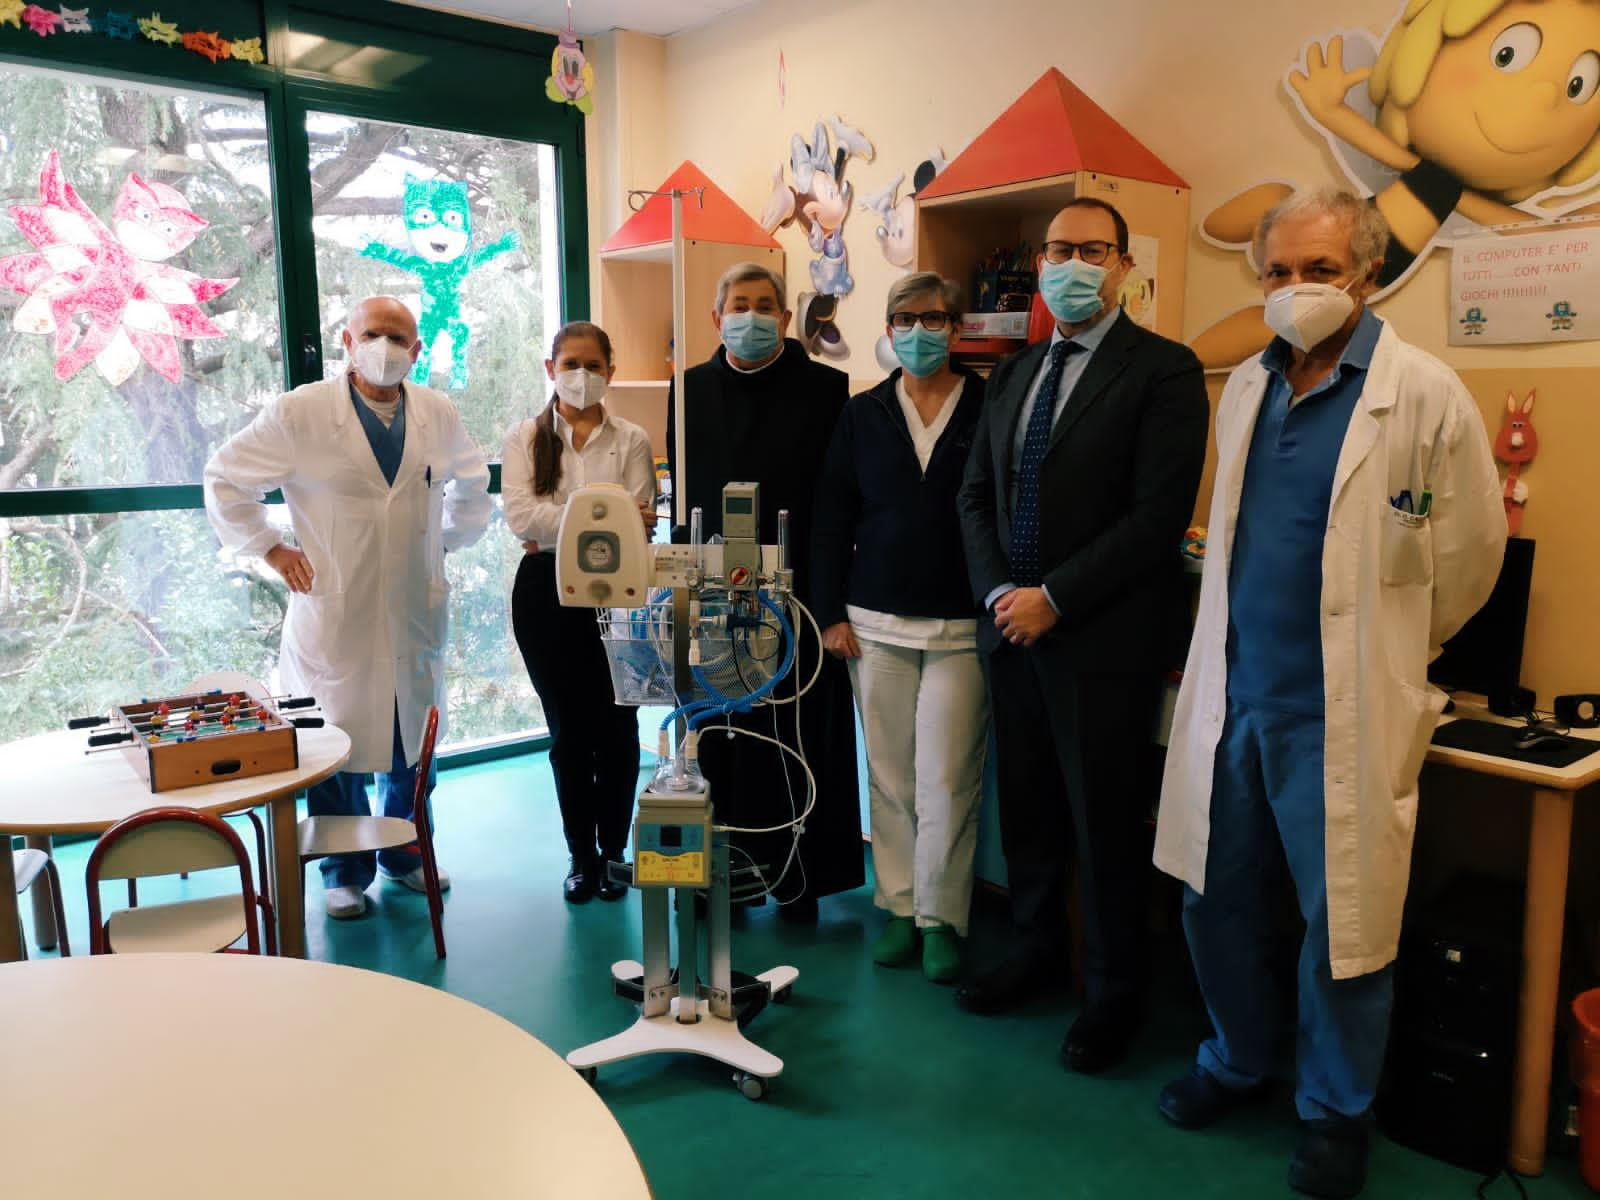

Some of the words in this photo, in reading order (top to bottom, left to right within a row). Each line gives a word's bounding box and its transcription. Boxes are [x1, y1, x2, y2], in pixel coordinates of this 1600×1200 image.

[1463, 255, 1471, 263] IL
[1477, 247, 1542, 263] COMPUTER
[1566, 242, 1589, 254] PER
[1546, 263, 1581, 274] TANTI
[1460, 289, 1498, 301] GIOCHI
